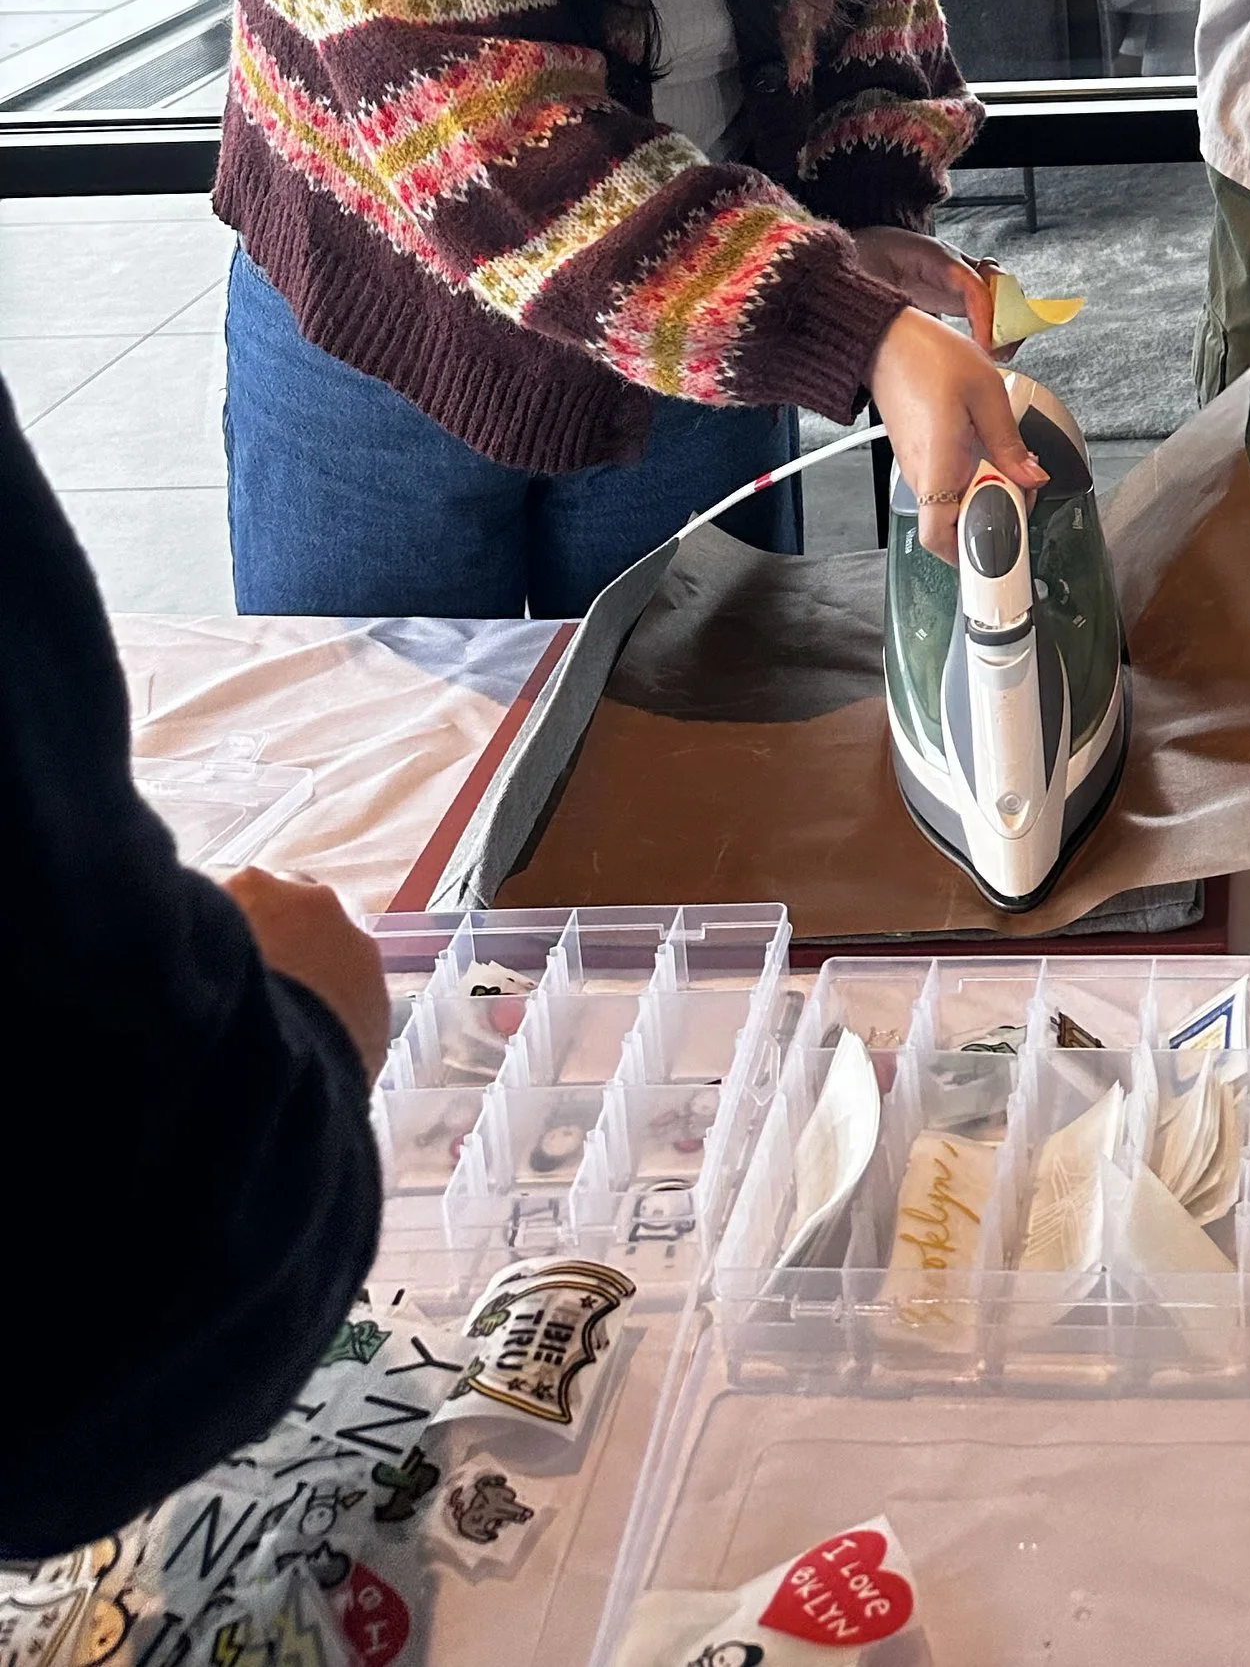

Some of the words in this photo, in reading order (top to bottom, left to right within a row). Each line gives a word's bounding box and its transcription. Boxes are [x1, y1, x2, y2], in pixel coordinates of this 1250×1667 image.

[496, 1309, 545, 1370] TRU
[533, 1321, 576, 1366] BE
[821, 1539, 857, 1562] I
[790, 1566, 860, 1639] BKLYN
